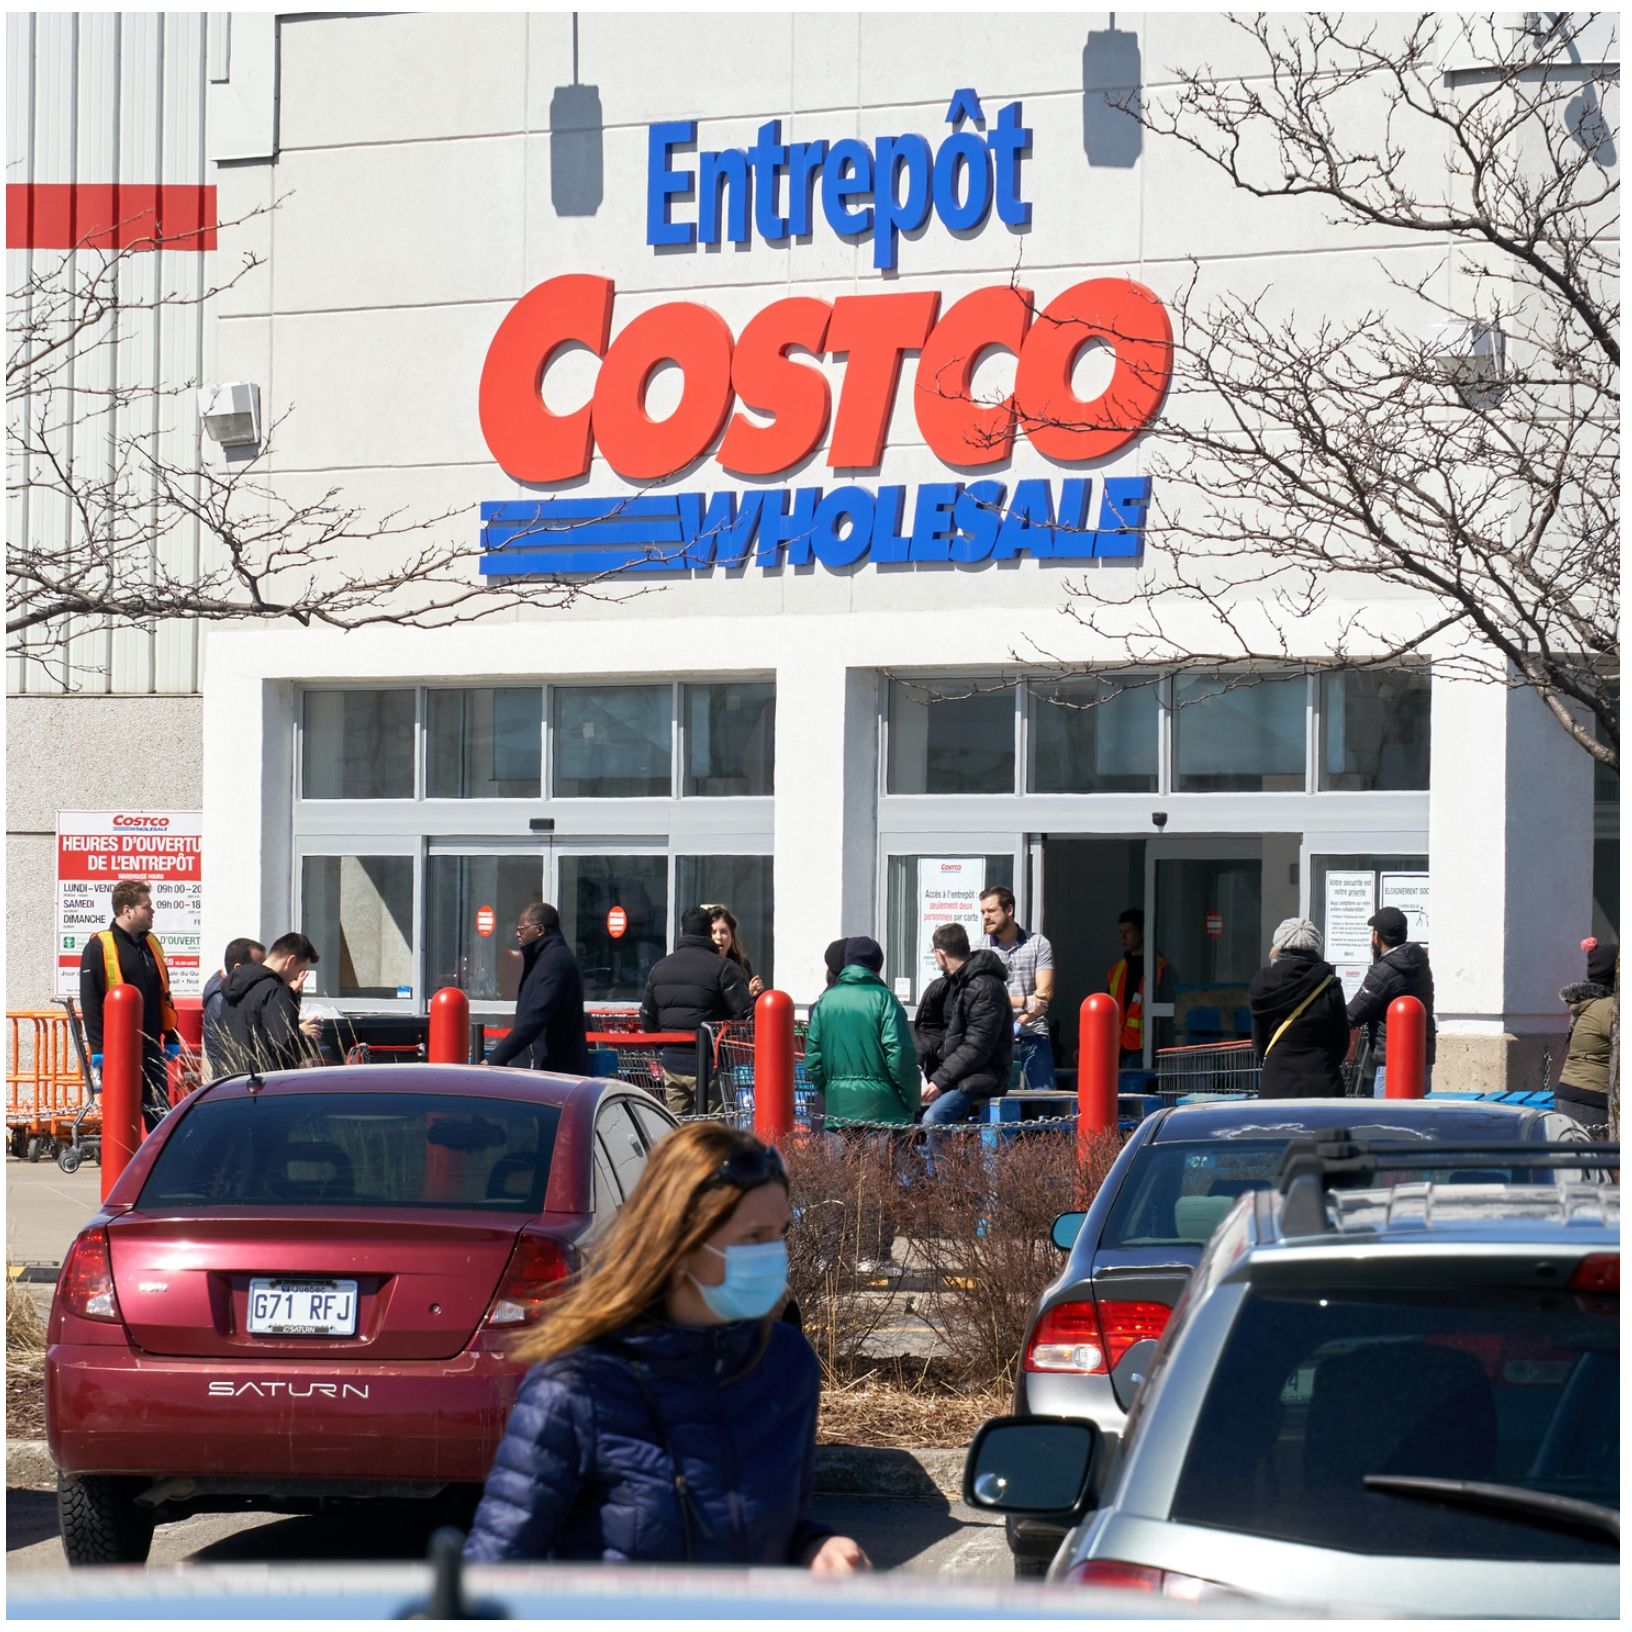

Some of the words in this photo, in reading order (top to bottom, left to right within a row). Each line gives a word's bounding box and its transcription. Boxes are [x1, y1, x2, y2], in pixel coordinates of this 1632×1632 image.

[647, 88, 1033, 269] Entrepôt
[676, 476, 1153, 568] WHOLESALE
[62, 836, 119, 852] HEURES
[87, 856, 108, 871] DE
[111, 852, 195, 872] L'ENTREPÔT
[63, 899, 95, 909] SAMEDI
[63, 914, 106, 924] DIMANCHE
[254, 1293, 293, 1320] G71
[309, 1294, 351, 1321] RFJ
[208, 1381, 369, 1398] SATURN
